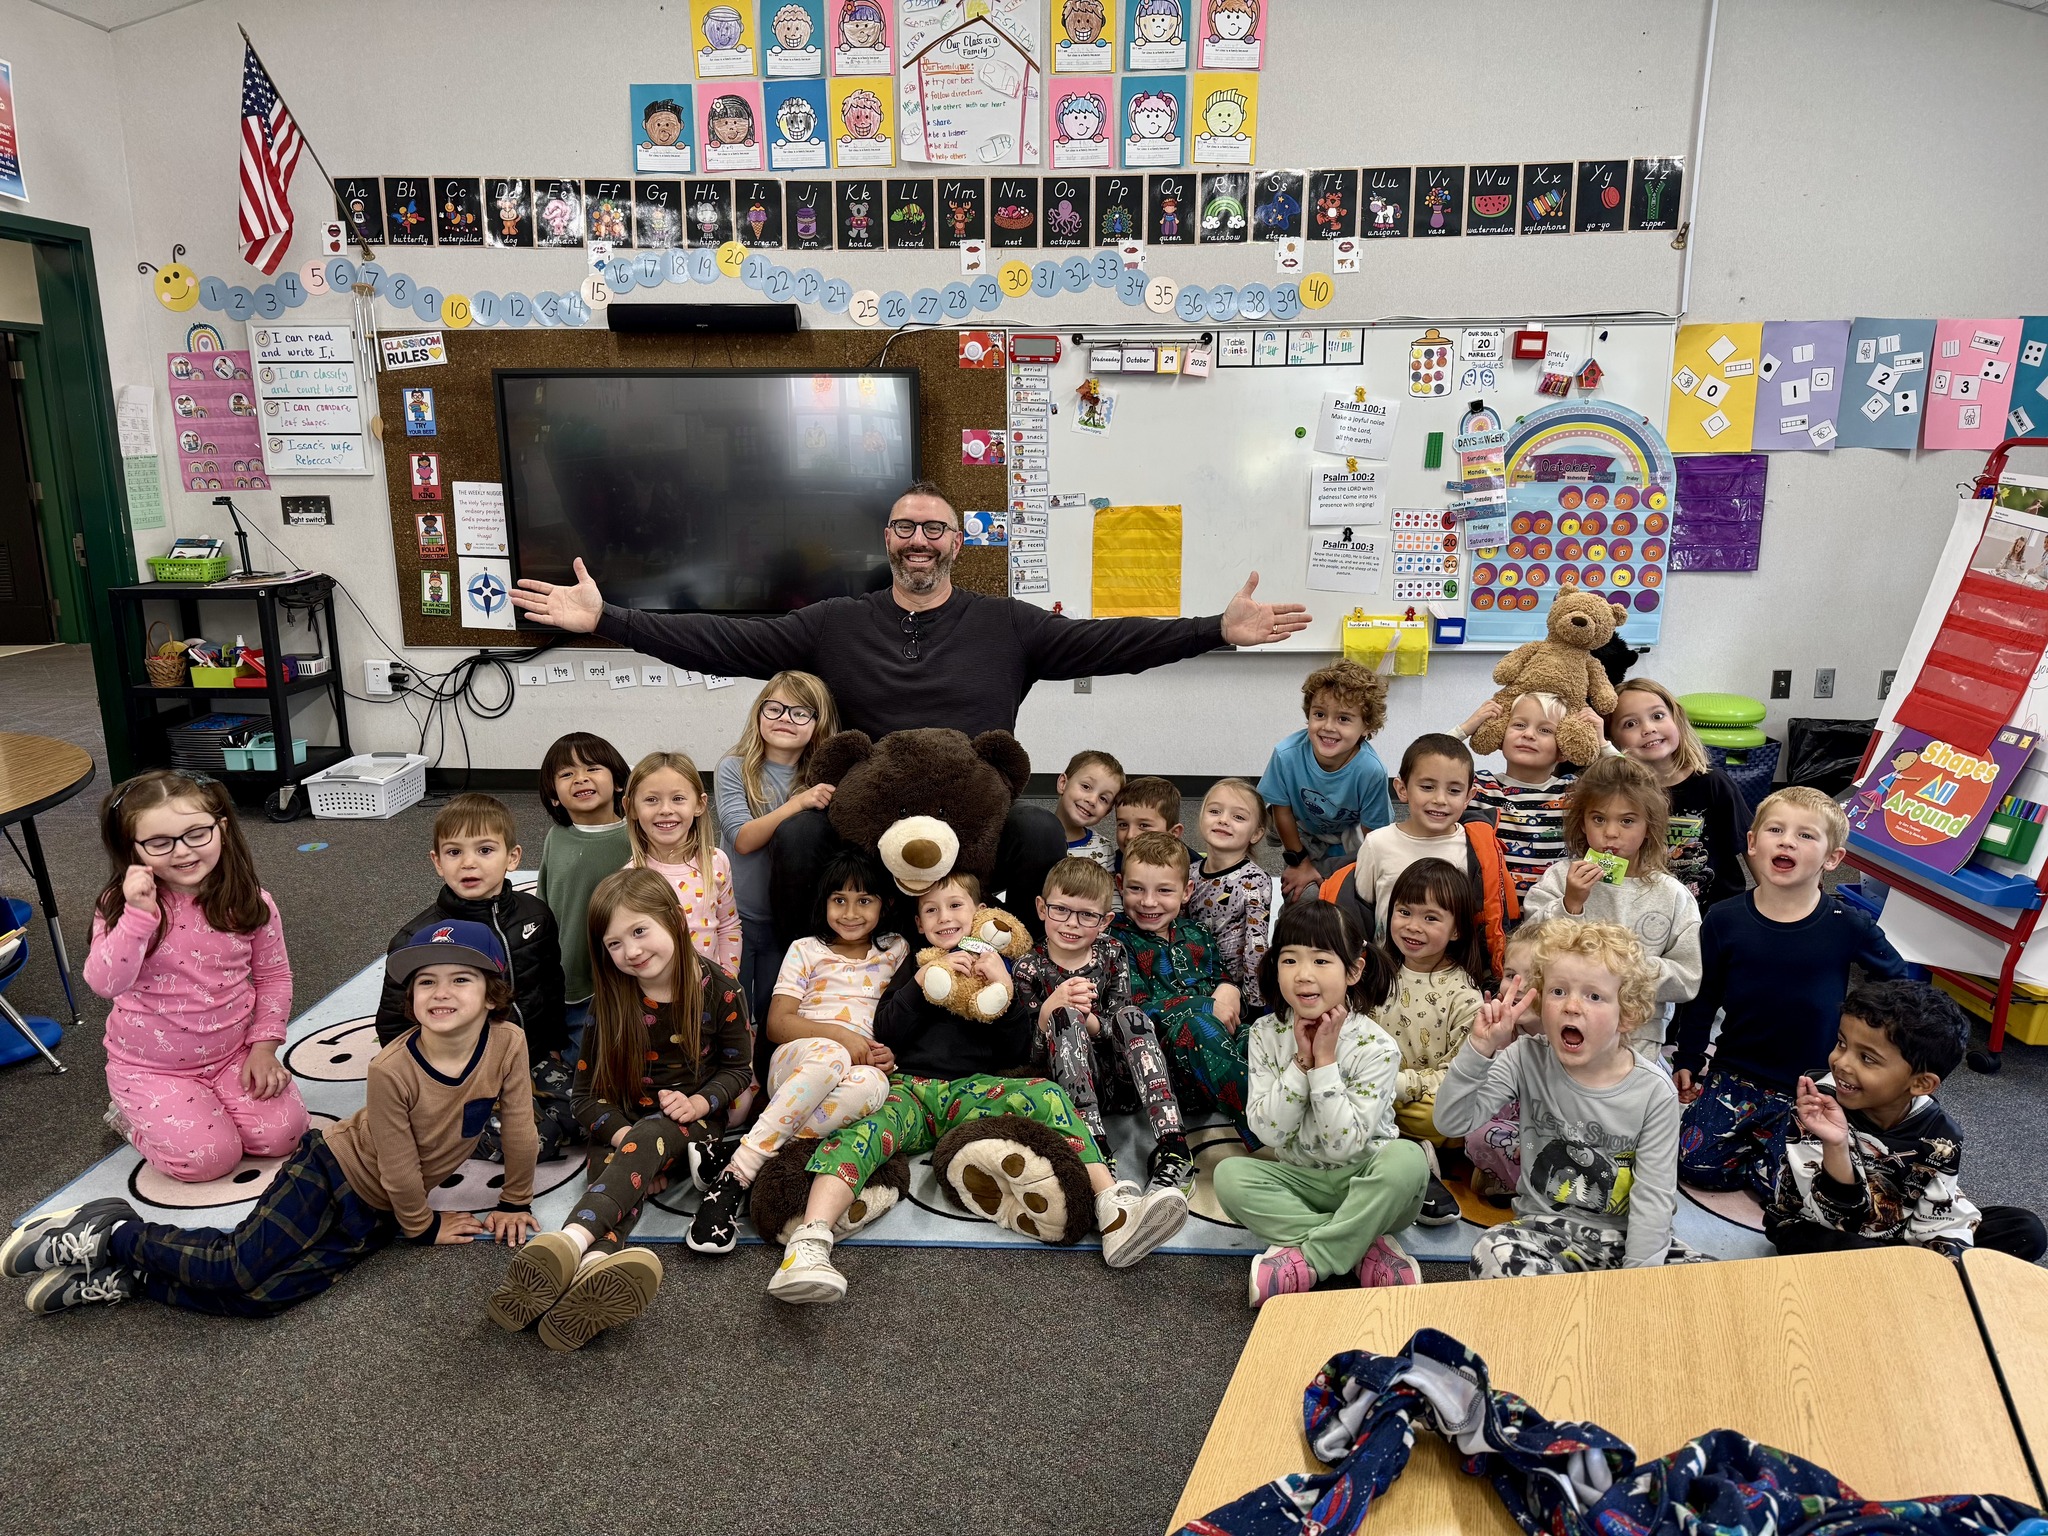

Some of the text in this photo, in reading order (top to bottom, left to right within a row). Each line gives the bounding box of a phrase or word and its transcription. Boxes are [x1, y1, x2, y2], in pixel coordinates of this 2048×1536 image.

[946, 39, 960, 50] Our
[964, 36, 982, 46] Class
[963, 47, 988, 57] Family
[932, 78, 944, 89] try
[930, 90, 950, 100] follow
[1428, 170, 1450, 187] Vv
[1476, 169, 1510, 186] Ww
[1532, 167, 1561, 184] Xx
[1590, 164, 1613, 189] Yy
[1644, 162, 1670, 180] Zz
[1212, 176, 1236, 194] Rr
[1267, 176, 1288, 193] Ss
[1323, 173, 1343, 190] Tt
[1371, 172, 1399, 188] Uu
[345, 181, 368, 198] Aa
[397, 181, 417, 198] Bb
[446, 181, 467, 198] Cc
[548, 183, 568, 200] Ee
[597, 183, 621, 200] Ff
[646, 184, 668, 207] Gg
[694, 184, 720, 200] Hh
[750, 183, 766, 200] Ii
[799, 185, 818, 208] Jj
[845, 184, 871, 201] Kk
[900, 183, 918, 200] Ll
[944, 182, 977, 200] Mm
[1000, 182, 1026, 198] Nn
[1054, 181, 1076, 198] Oo
[1108, 180, 1129, 204] Pp
[1160, 178, 1183, 202] Qq
[1368, 228, 1401, 238] unicorn
[1466, 225, 1514, 234] watermelon
[1524, 222, 1566, 234] xylophone
[1640, 219, 1666, 230] zipper
[392, 233, 429, 246] butterfly
[438, 232, 482, 244] caterpillar
[1004, 236, 1022, 246] nest
[1050, 236, 1081, 248] octopus
[1321, 228, 1342, 240] tiger
[801, 240, 819, 248] jam
[724, 249, 745, 266] 20
[311, 267, 324, 287] 5
[334, 264, 348, 285] 6
[613, 264, 629, 284] 16
[643, 259, 657, 278] 17
[748, 262, 764, 279] 21
[1097, 258, 1118, 280] 33
[286, 278, 298, 298] 4
[1008, 269, 1028, 290] 30
[210, 285, 218, 302] 1
[394, 280, 406, 300] 8
[591, 282, 607, 302] 15
[1154, 286, 1174, 306] 35
[1308, 280, 1328, 302] 40
[234, 294, 246, 309] 2
[266, 294, 277, 311] 3
[424, 294, 434, 314] 9
[510, 299, 525, 318] 12
[858, 299, 879, 318] 25
[886, 298, 906, 318] 26
[1184, 294, 1203, 315] 36
[1215, 292, 1234, 314] 37
[450, 302, 468, 320] 10
[272, 331, 334, 344] I can read
[384, 336, 440, 350] CLASSROOM
[1226, 338, 1246, 346] Table
[1478, 340, 1490, 349] 20
[261, 348, 281, 358] and
[288, 346, 314, 357] write
[387, 349, 430, 366] RULES
[1223, 346, 1248, 356] Points
[1547, 350, 1570, 361] Smelly
[1092, 356, 1207, 367] Wednesday October 29 2025
[276, 367, 348, 384] I can classify
[1878, 372, 1890, 386] 2
[271, 384, 352, 395] and count by size
[1706, 384, 1718, 398] 0
[1960, 380, 1970, 394] 3
[284, 402, 351, 414] I can compare
[1334, 400, 1386, 414] Psalm 100:1
[287, 439, 326, 451] Issac's
[1458, 433, 1505, 448] DAYS WEEK
[296, 454, 332, 466] Rebecca
[1542, 459, 1596, 473] October
[1322, 472, 1375, 482] Psalm 100:2
[1322, 540, 1374, 552] Psalm 100:3
[1444, 537, 1457, 548] 20
[1470, 537, 1494, 545] Saturday
[1444, 584, 1457, 594] 40
[554, 666, 568, 676] the
[590, 666, 605, 675] and
[615, 674, 630, 683] see
[1921, 741, 2000, 784] Shapes
[1915, 773, 1959, 806] All
[1882, 790, 1970, 838] Around
